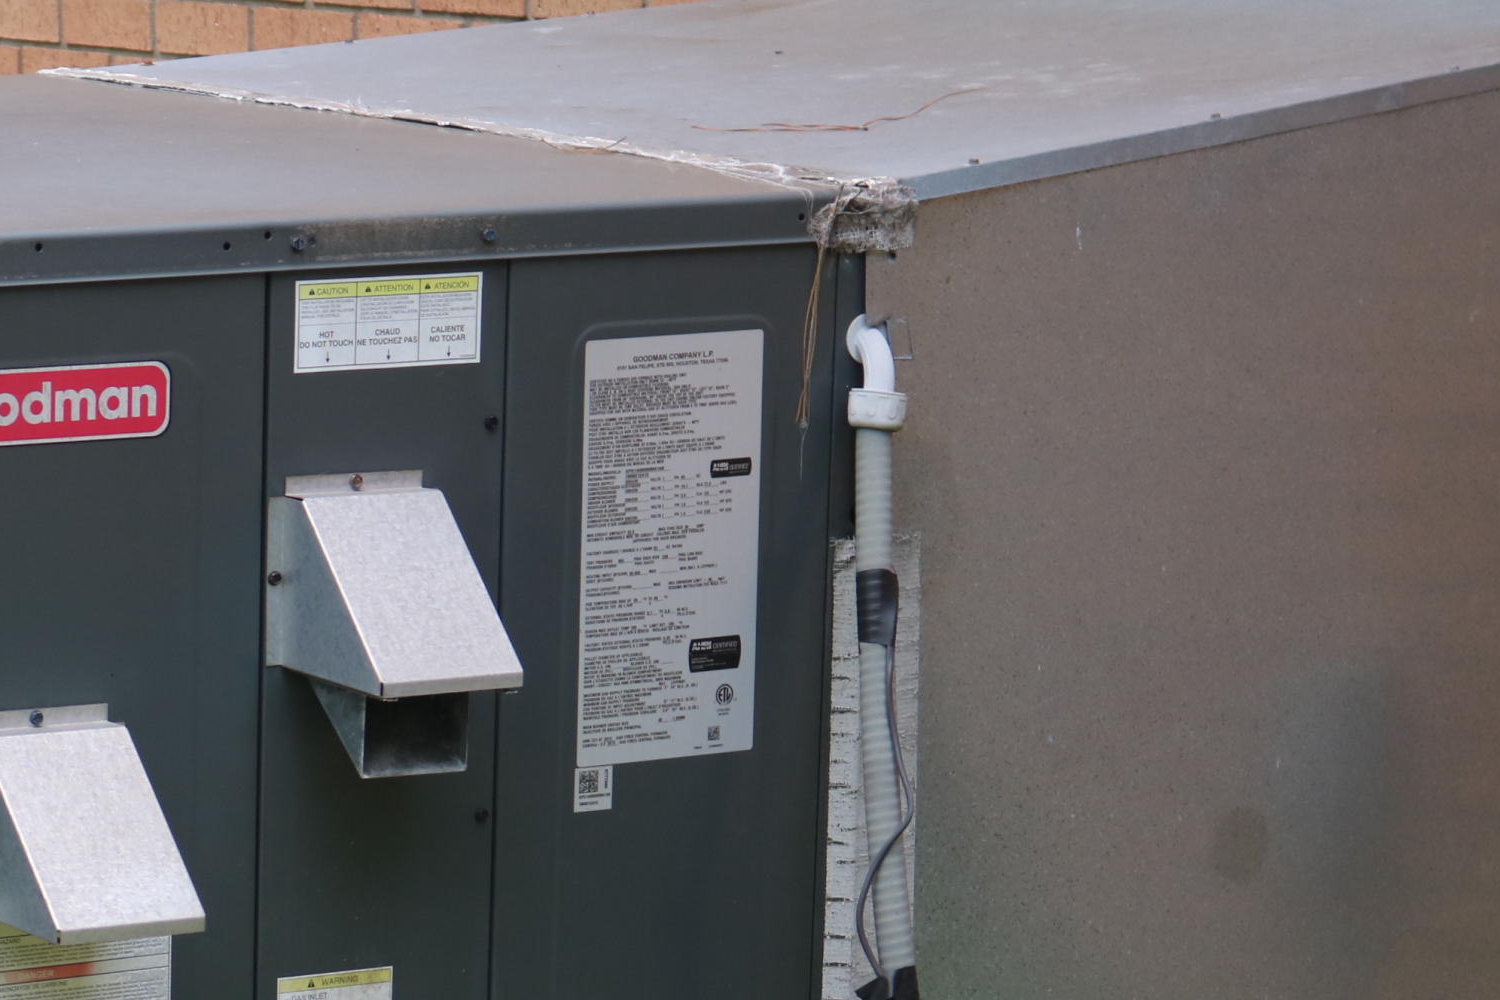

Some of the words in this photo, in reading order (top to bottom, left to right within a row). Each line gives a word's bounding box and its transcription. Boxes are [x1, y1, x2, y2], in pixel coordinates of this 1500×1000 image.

[374, 328, 401, 336] CHAUD
[431, 324, 466, 334] CALIENTE
[319, 331, 334, 339] HOT
[441, 334, 466, 342] TOCAR
[329, 339, 354, 348] TOUCH
[368, 337, 402, 346] TOUCHEZ
[403, 336, 418, 344] PAS
[632, 352, 668, 363] GOODMAN
[668, 350, 702, 360] COMPANY
[322, 975, 358, 986] WARNING
